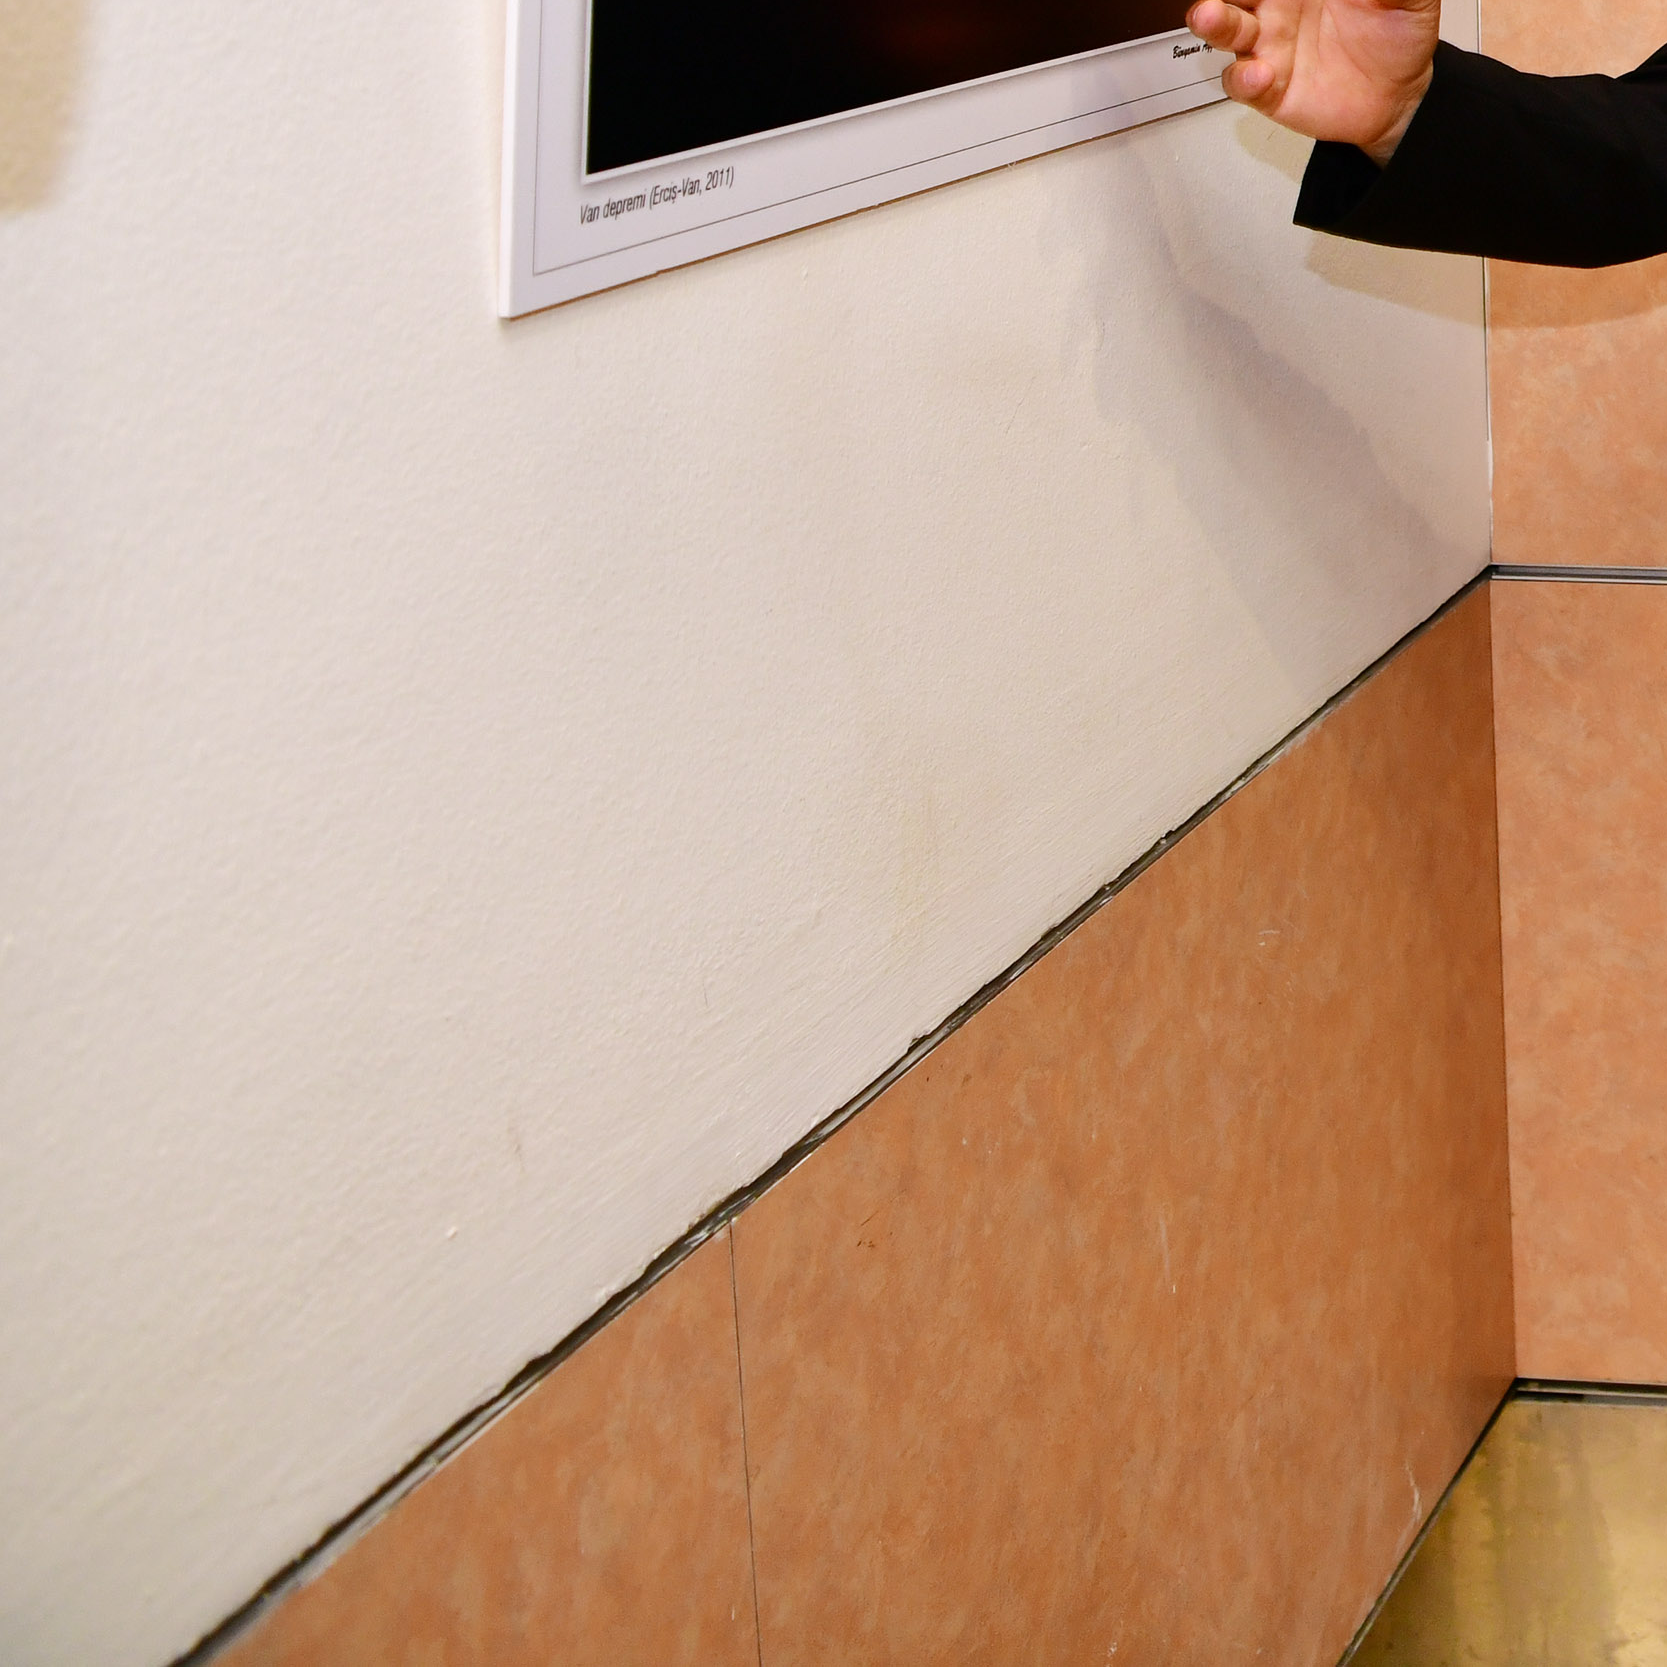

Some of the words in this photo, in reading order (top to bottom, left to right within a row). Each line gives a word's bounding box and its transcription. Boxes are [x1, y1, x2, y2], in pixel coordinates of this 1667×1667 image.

[580, 205, 600, 225] Van
[603, 188, 647, 220] depremi
[705, 166, 734, 190] 2011)
